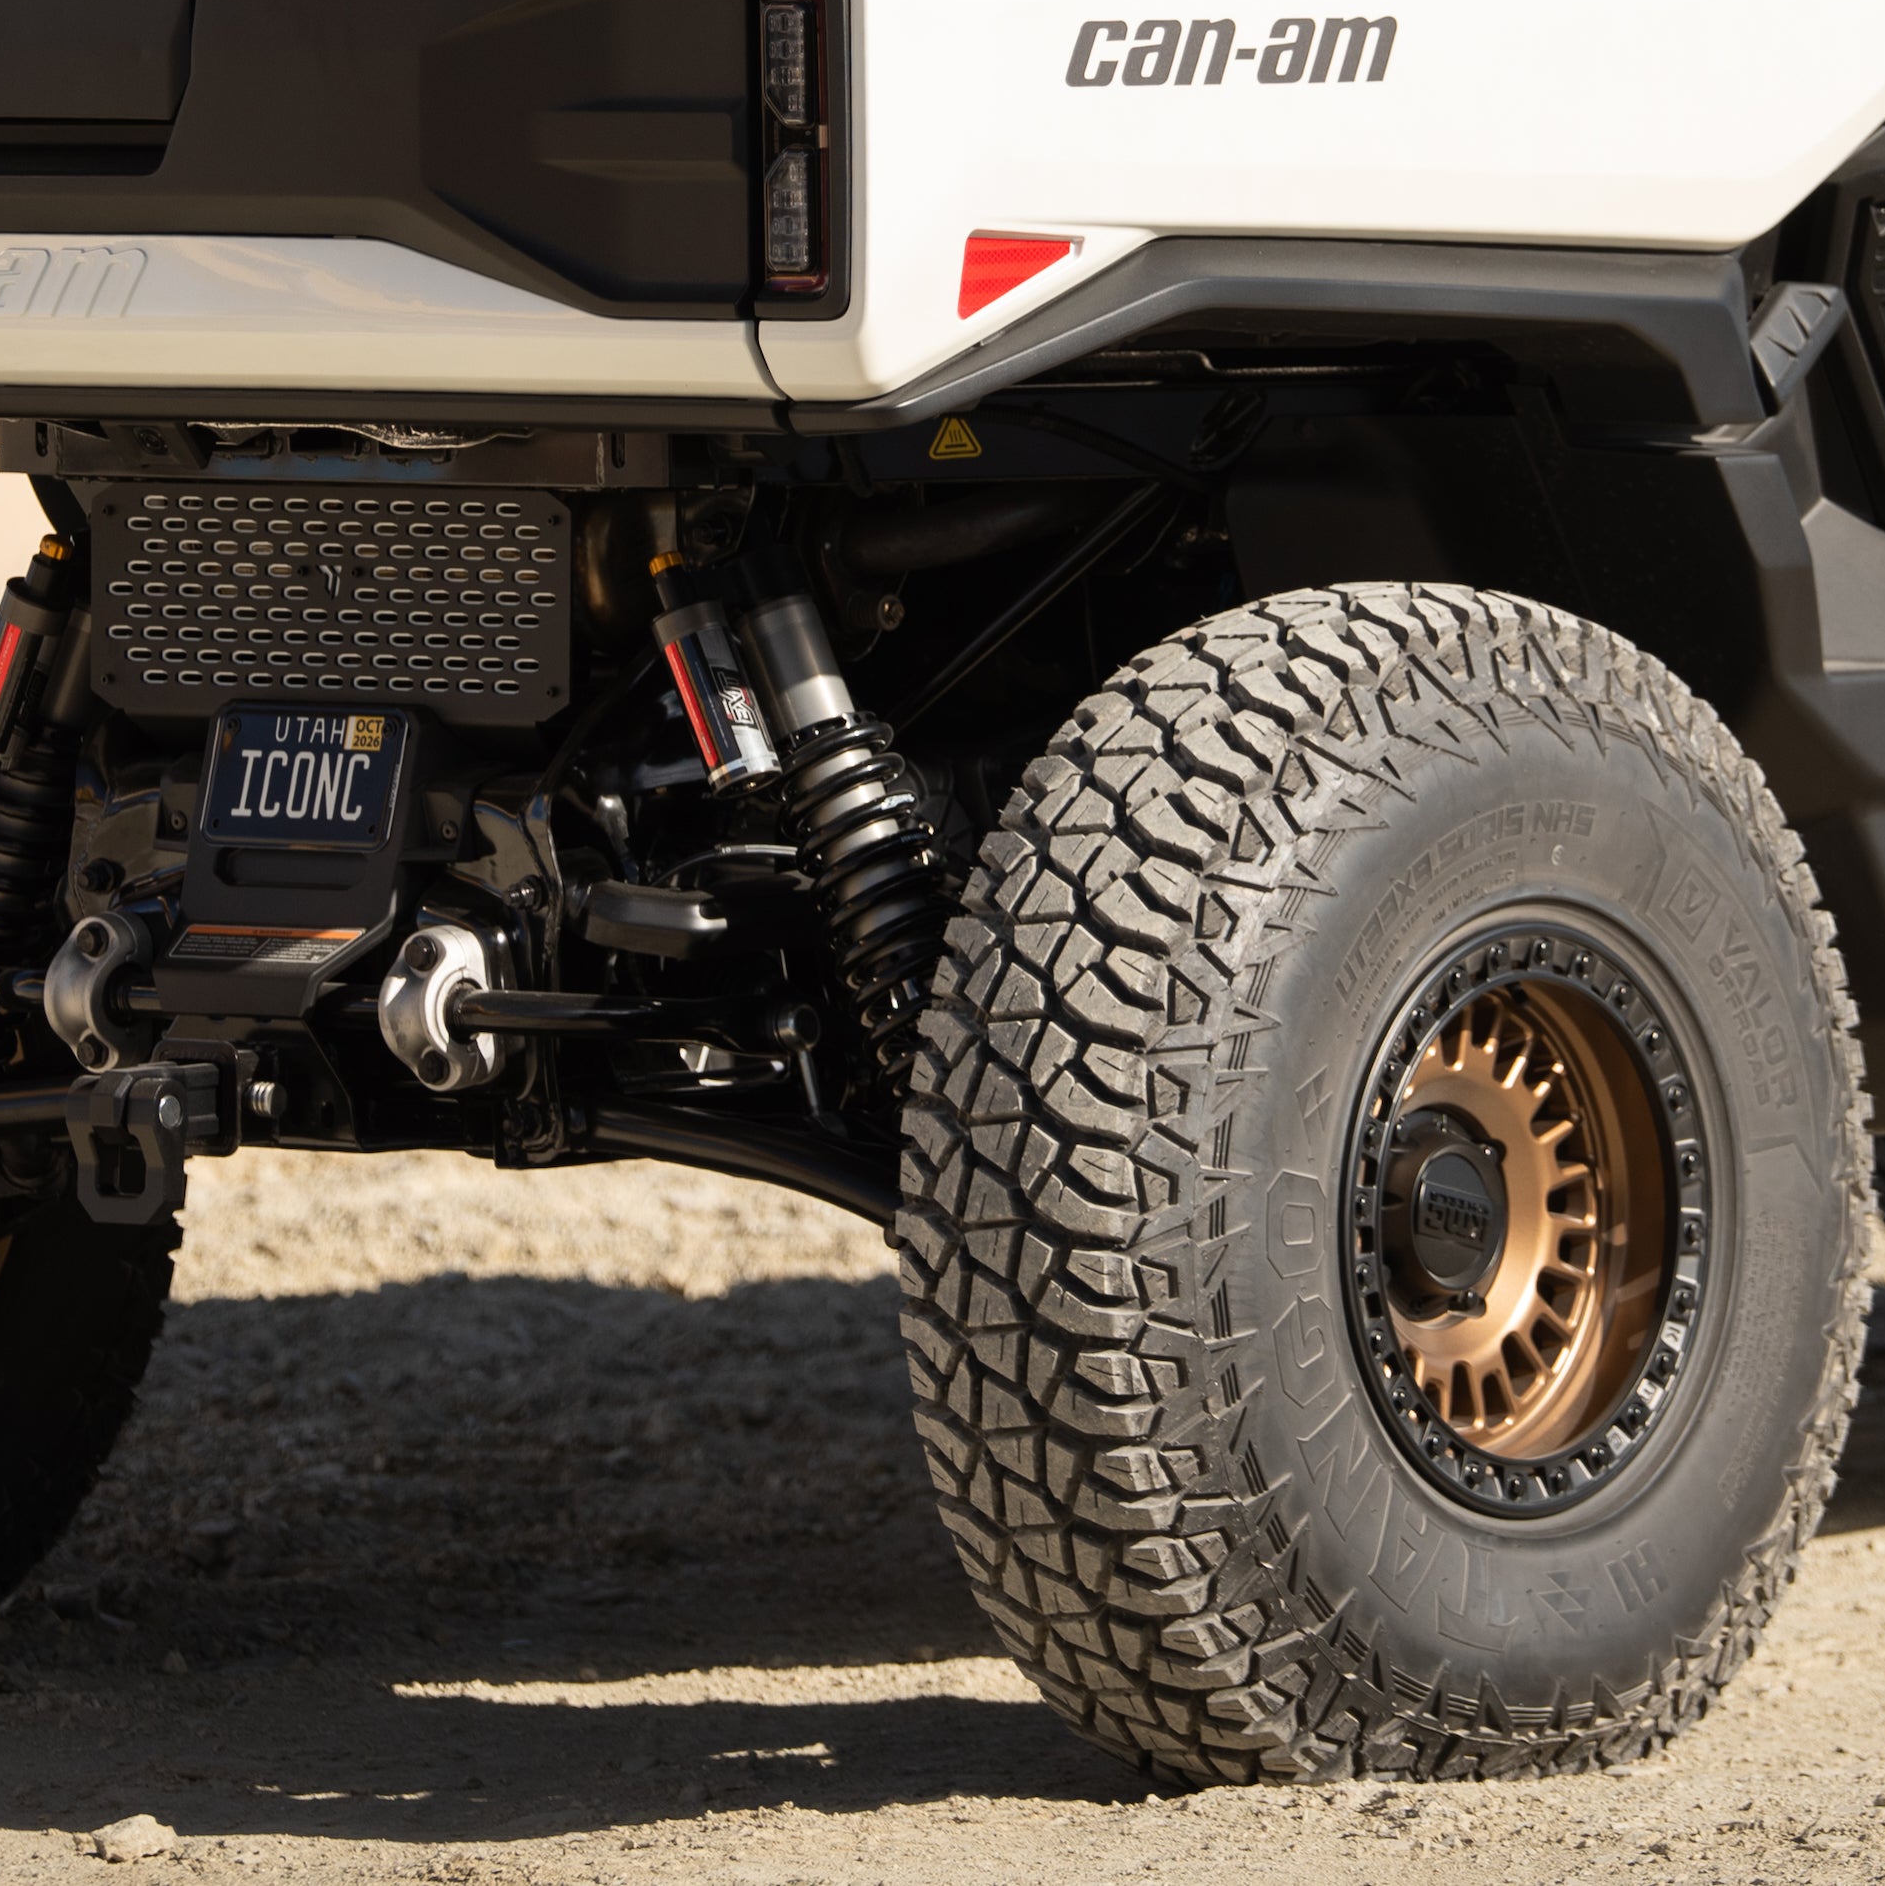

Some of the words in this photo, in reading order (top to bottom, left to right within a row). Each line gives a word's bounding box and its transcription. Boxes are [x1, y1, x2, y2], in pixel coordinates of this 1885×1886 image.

[1065, 16, 1398, 88] can-am
[274, 715, 346, 746] UTAH
[352, 734, 381, 748] 2026
[355, 718, 384, 733] OCT
[230, 748, 371, 822] ICONC
[1532, 800, 1597, 837] NHS
[1707, 953, 1770, 1106] OFFROAD
[1720, 917, 1798, 1111] VALOR
[1265, 1169, 1522, 1653] TANGO
